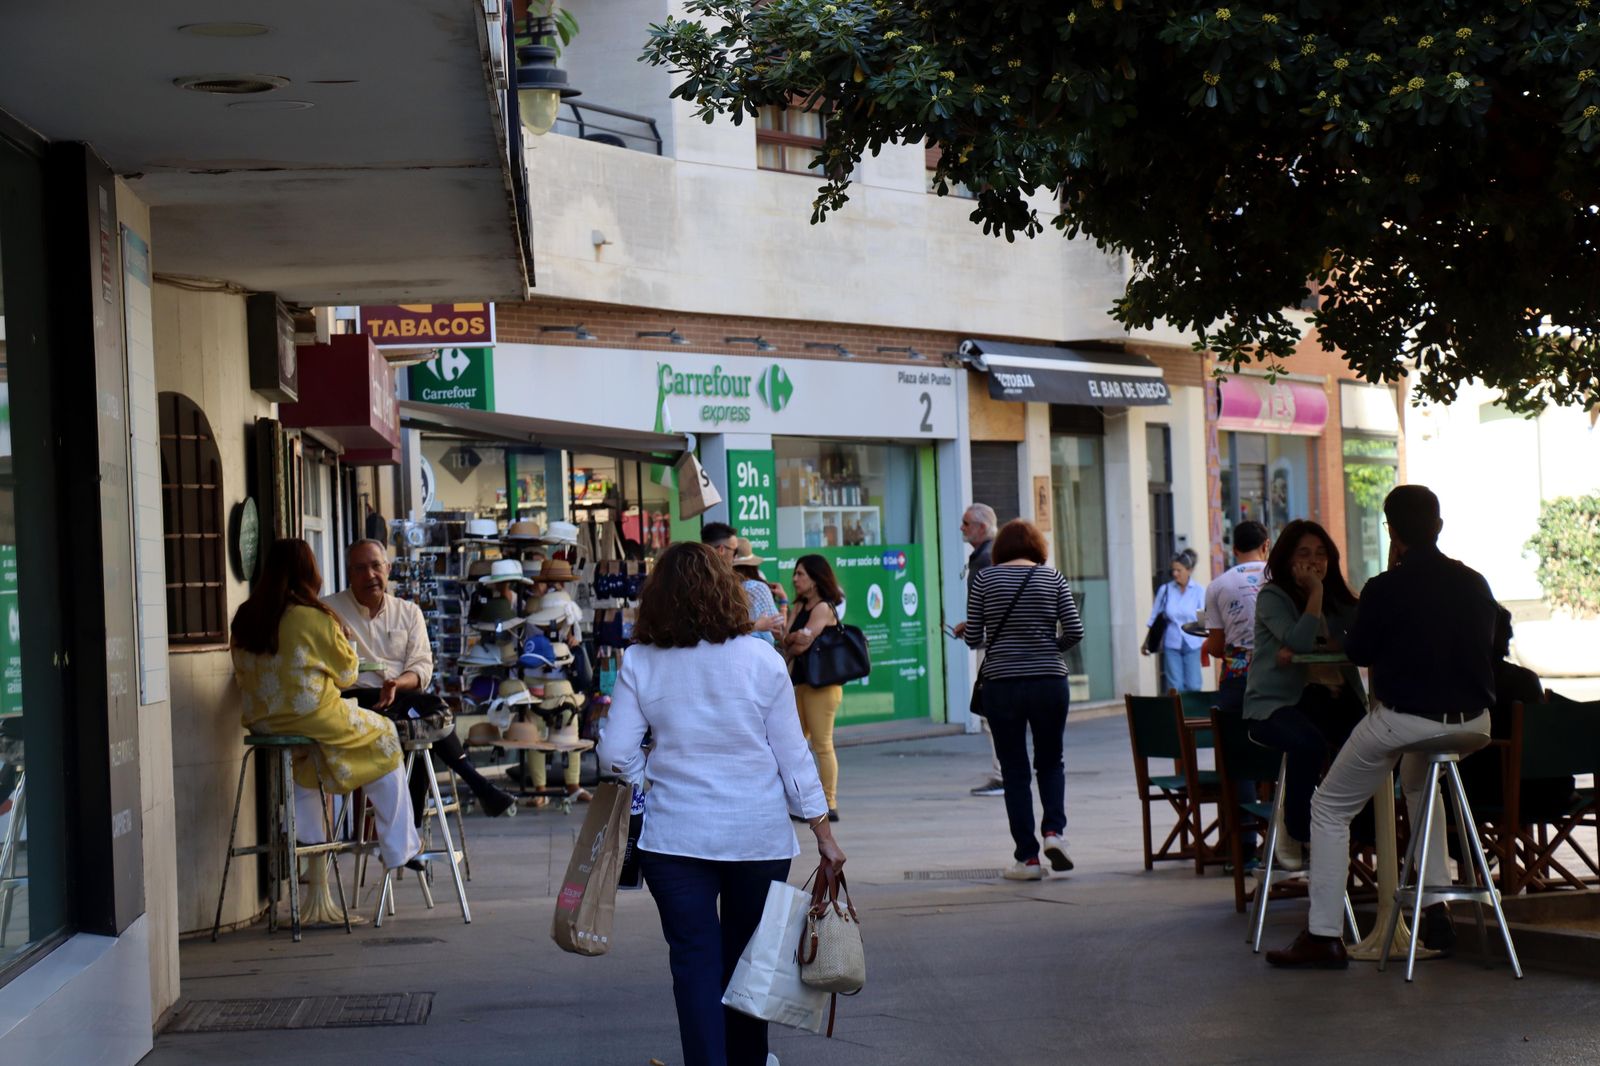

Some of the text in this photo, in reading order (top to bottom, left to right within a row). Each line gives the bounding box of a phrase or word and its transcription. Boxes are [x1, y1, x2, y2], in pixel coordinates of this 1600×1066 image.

[367, 316, 486, 337] TABACOS
[660, 363, 752, 397] Carrefour
[898, 371, 952, 386] Plaza del Punto
[1088, 380, 1167, 399] EL BAR DE DIEGO
[422, 385, 477, 401] Carrefour
[702, 404, 751, 427] express
[919, 391, 933, 432] 2
[737, 461, 770, 488] 9h a
[738, 494, 770, 520] 22h
[741, 526, 749, 536] de
